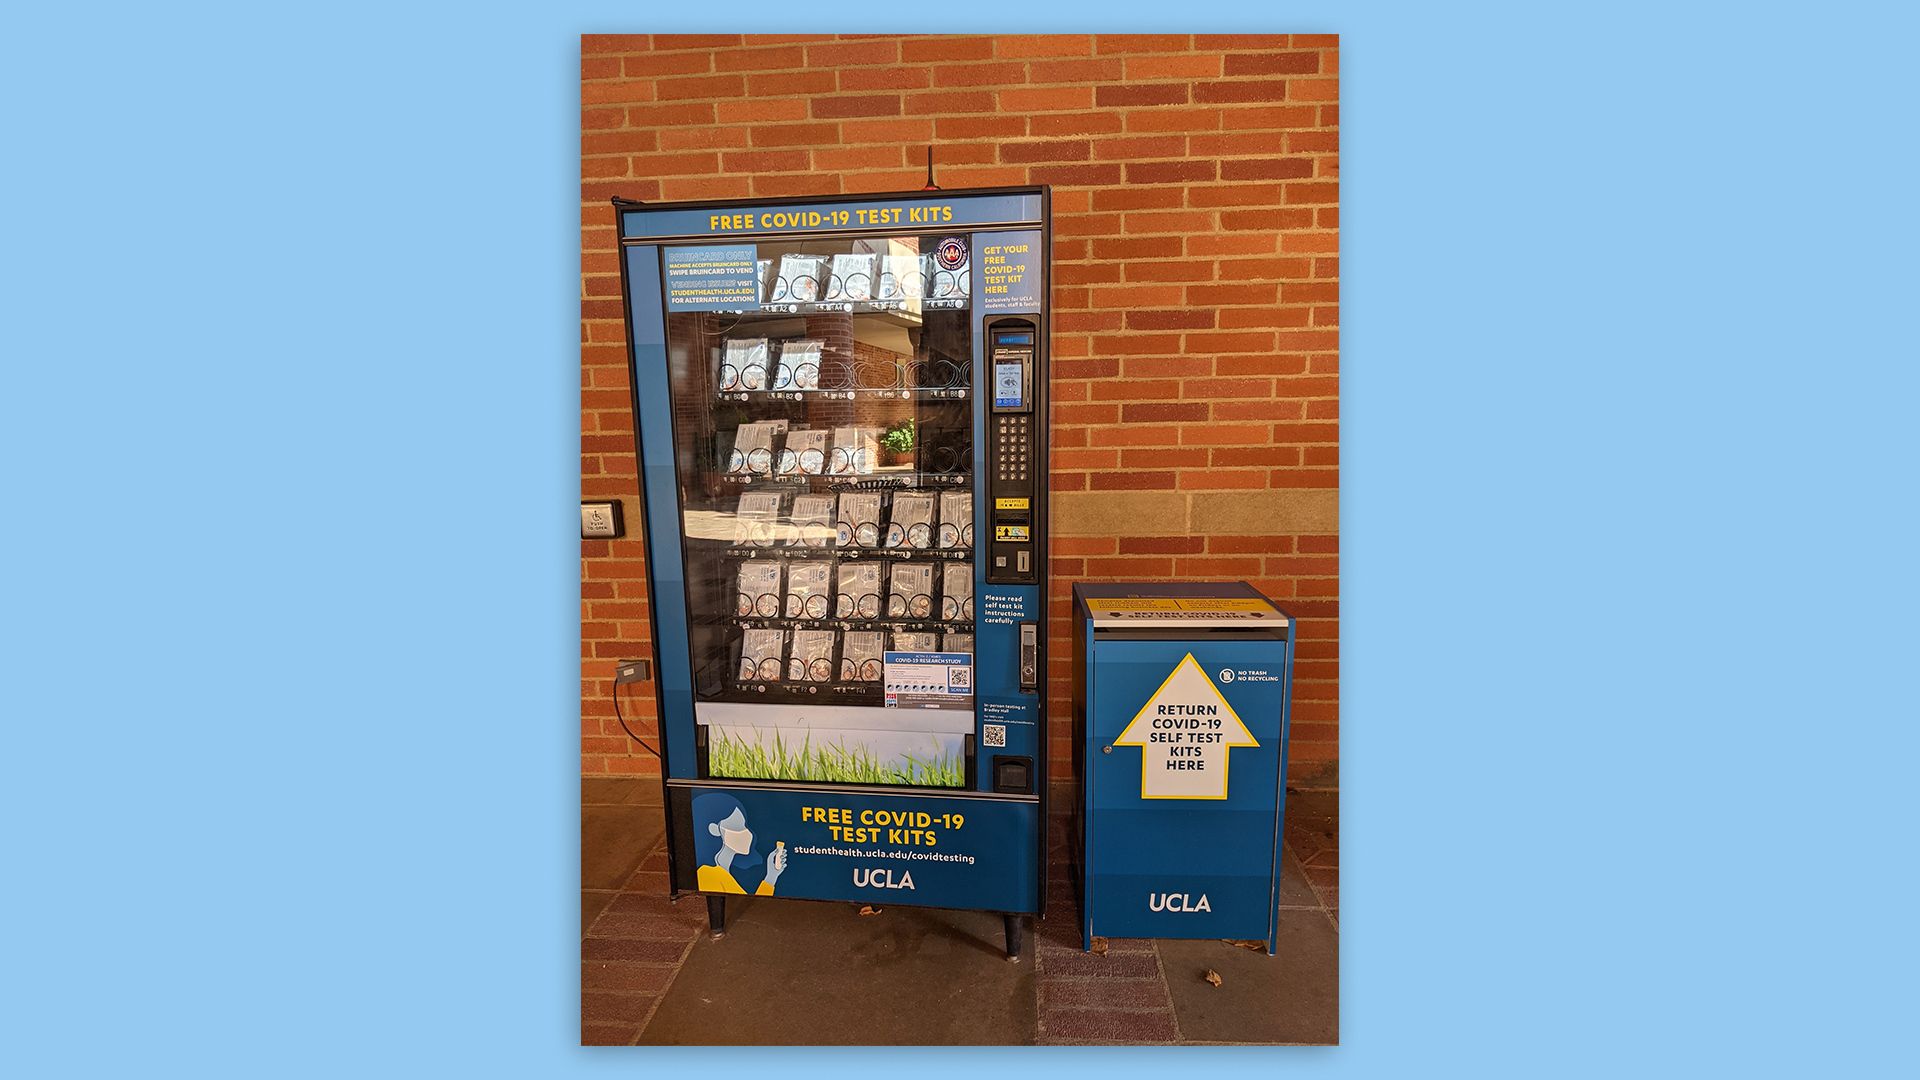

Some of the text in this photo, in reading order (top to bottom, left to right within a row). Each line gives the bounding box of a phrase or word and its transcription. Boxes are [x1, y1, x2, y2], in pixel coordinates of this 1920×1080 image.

[710, 206, 953, 230] FREE COVID-19 TEST KITS
[984, 244, 1028, 254] GET YOUR
[984, 256, 1006, 264] FREE
[984, 265, 1026, 274] COVID-19
[984, 274, 1022, 284] TEST KIT
[671, 288, 755, 296] STUDENTHEALTH.UCLA.EDU
[984, 286, 1008, 294] HERE
[1158, 705, 1217, 715] RETURN
[1152, 719, 1222, 729] COVID-19
[1150, 732, 1223, 743] SELF TEST
[1170, 747, 1202, 757] KITS
[1167, 760, 1205, 770] HERE
[801, 807, 965, 830] FREE COVID-19
[829, 826, 937, 846] TEST KITS
[794, 846, 975, 864] studenthealth.ucla.edu/covidtesting
[853, 868, 916, 890] UCLA
[1149, 893, 1212, 912] UCLA
